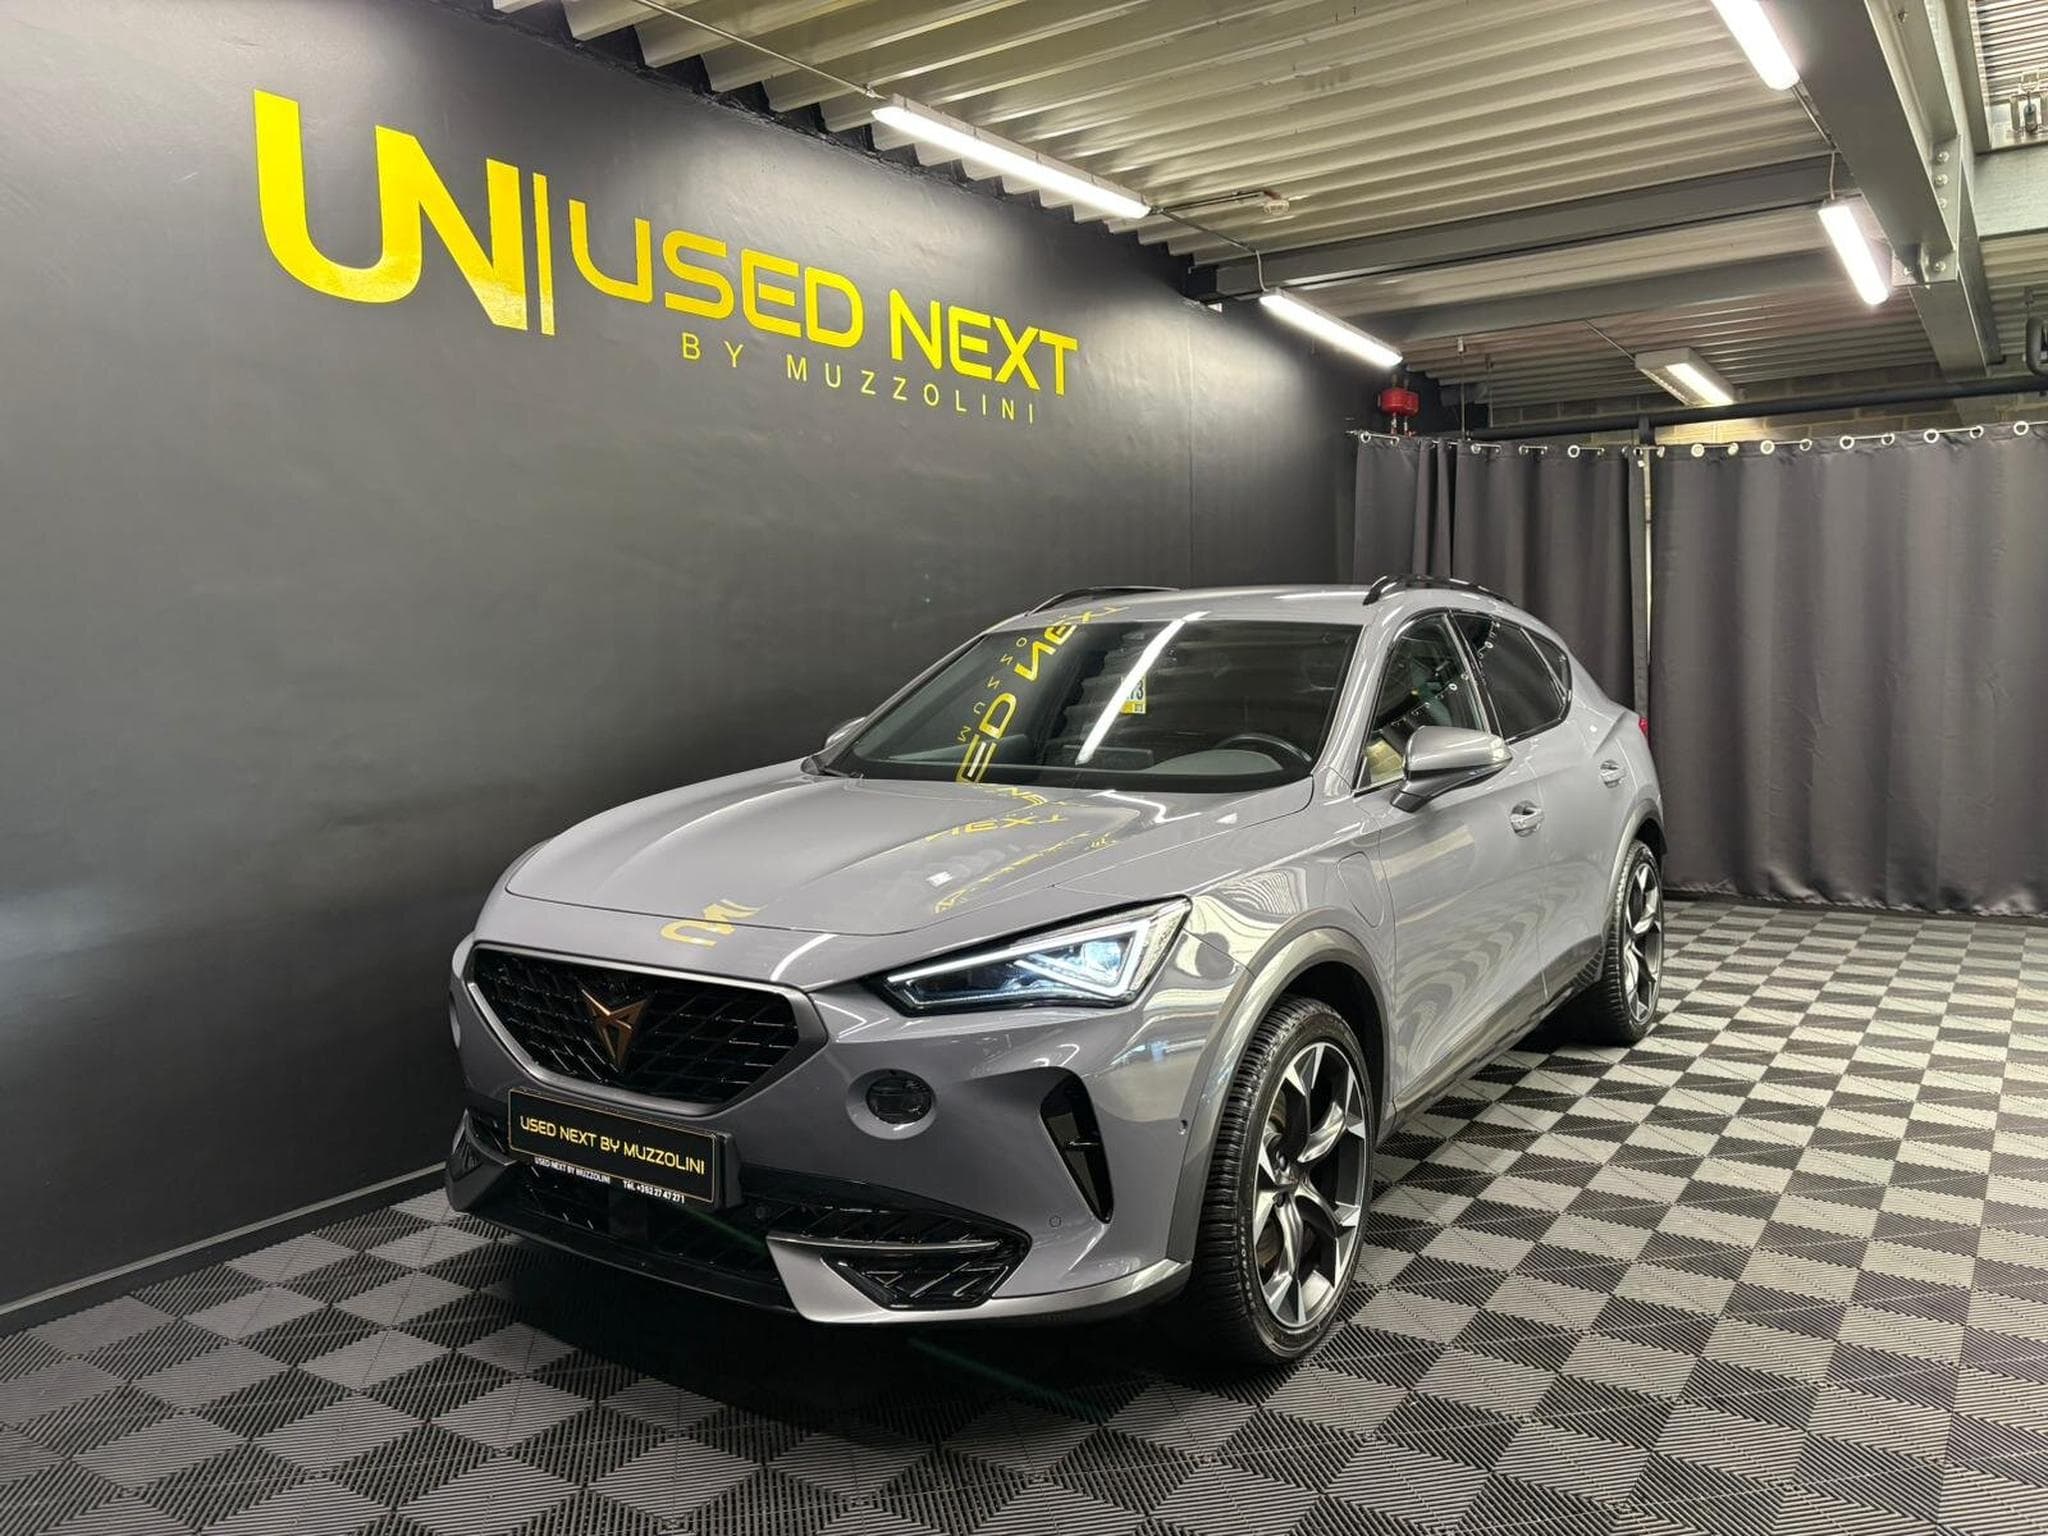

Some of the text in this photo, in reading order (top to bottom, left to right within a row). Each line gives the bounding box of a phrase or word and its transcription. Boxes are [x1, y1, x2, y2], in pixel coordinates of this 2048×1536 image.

[568, 198, 1080, 397] USED NEXT
[681, 333, 1034, 424] BY MUZZOLINI
[520, 1115, 705, 1175] USED NEXT BY MUZZOLINI
[535, 1156, 551, 1167] USED
[551, 1161, 566, 1172] NEXT
